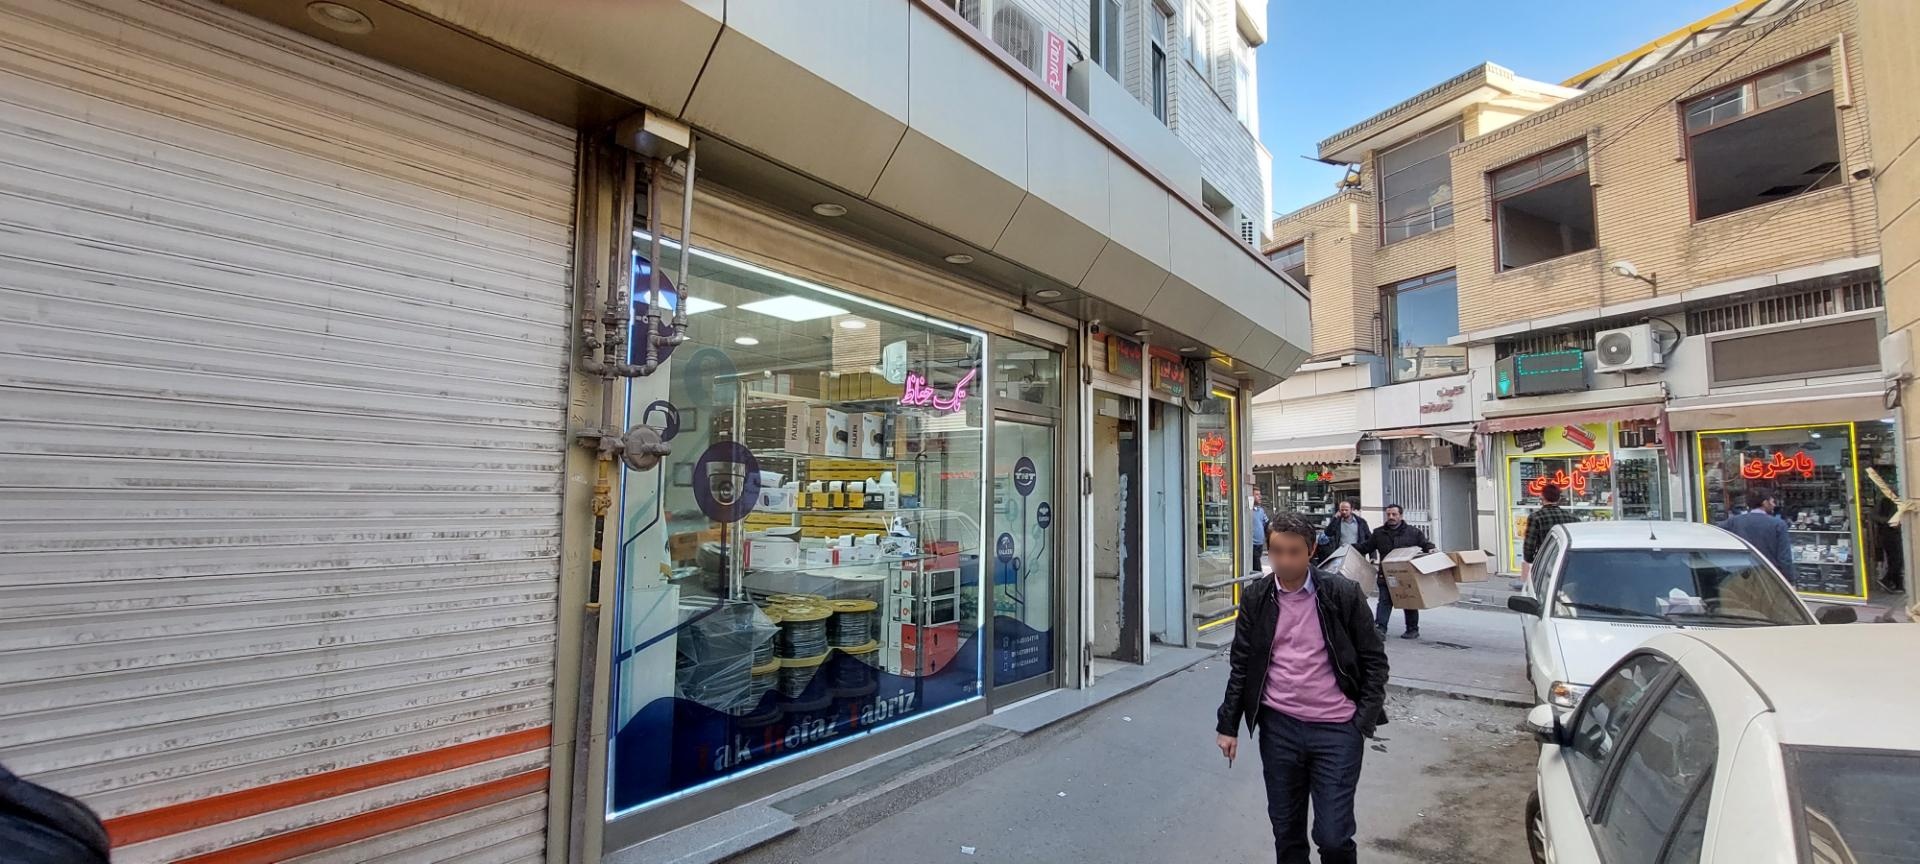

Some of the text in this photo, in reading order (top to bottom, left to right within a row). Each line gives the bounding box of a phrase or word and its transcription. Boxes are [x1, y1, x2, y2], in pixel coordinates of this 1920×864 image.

[901, 367, 977, 412] تک حفاظ
[790, 414, 799, 441] FALKEN
[1014, 472, 1036, 480] TNT
[1578, 453, 1612, 473] ایران
[1743, 451, 1815, 480] باطری
[848, 689, 915, 729] Tabriz
